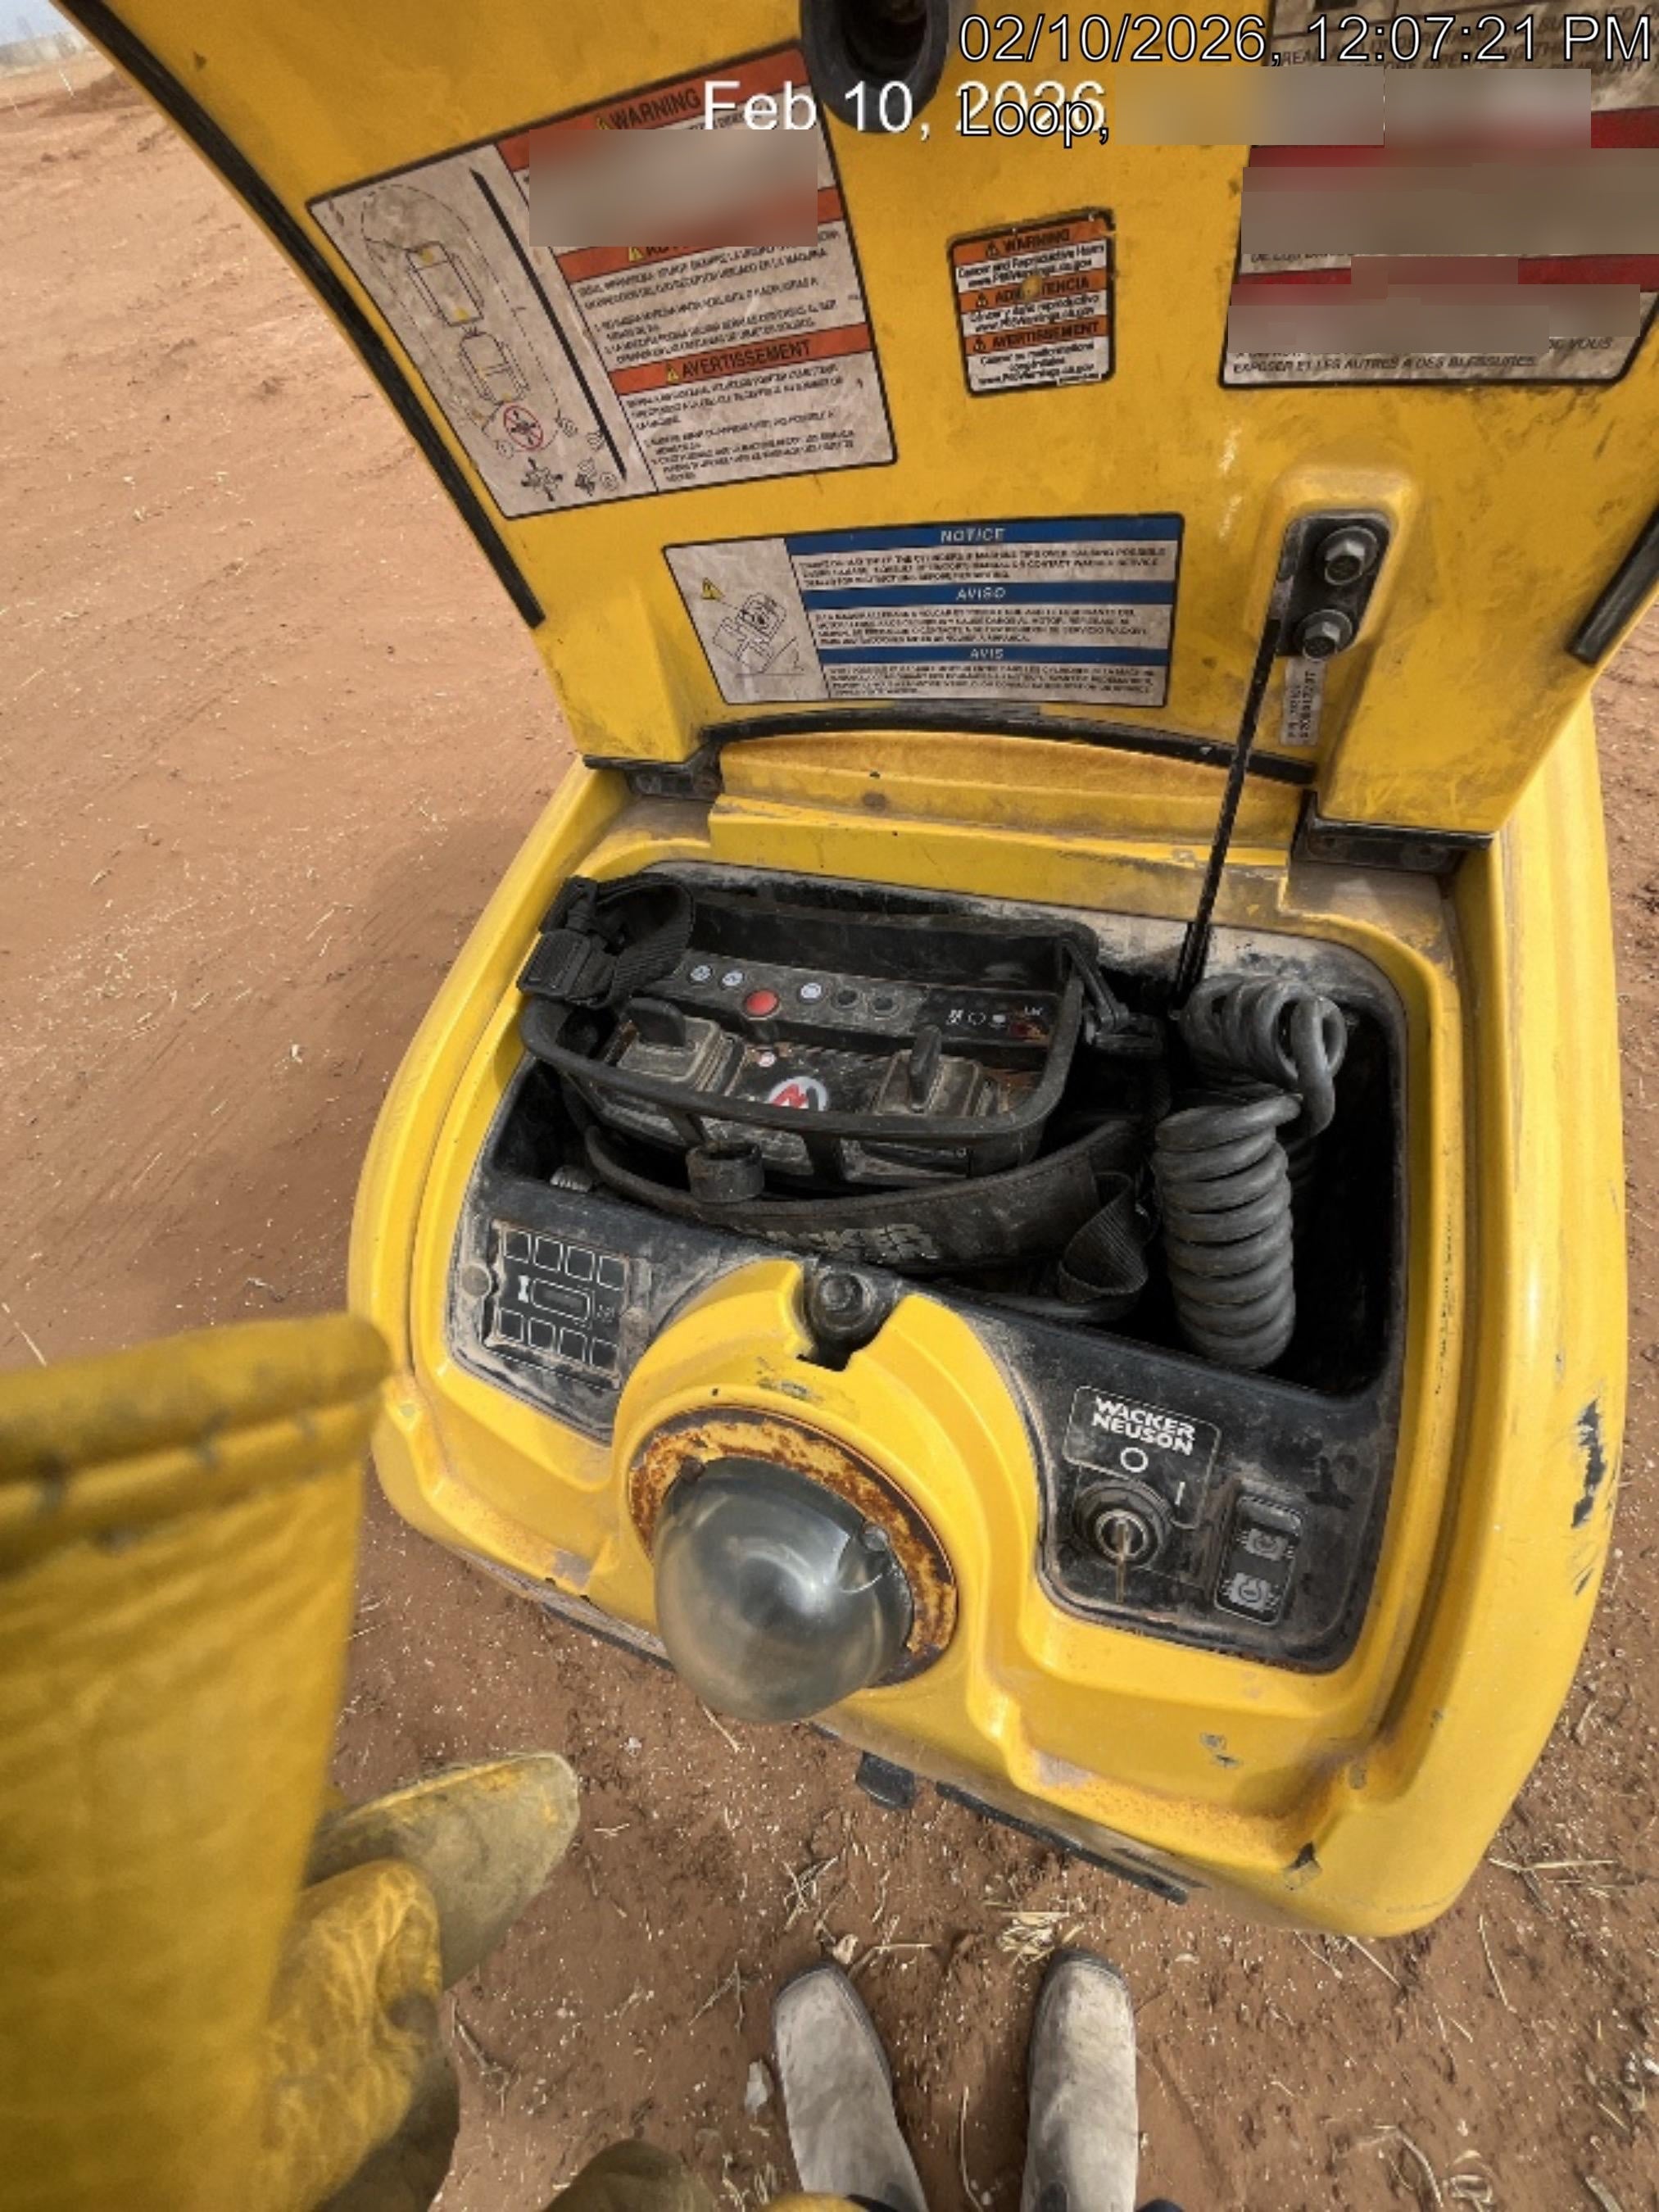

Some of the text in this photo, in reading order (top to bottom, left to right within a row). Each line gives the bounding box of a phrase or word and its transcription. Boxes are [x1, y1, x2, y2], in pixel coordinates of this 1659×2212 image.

[609, 88, 702, 131] WARNING
[1004, 229, 1071, 252] WARNING
[682, 339, 813, 379] AVERTISSEMENT
[940, 528, 1007, 544] NOTICE
[955, 586, 1007, 602] AVISO
[969, 647, 1004, 660] AVIS
[1095, 1395, 1196, 1439] WACKER
[1091, 1412, 1194, 1456] NEUSON
